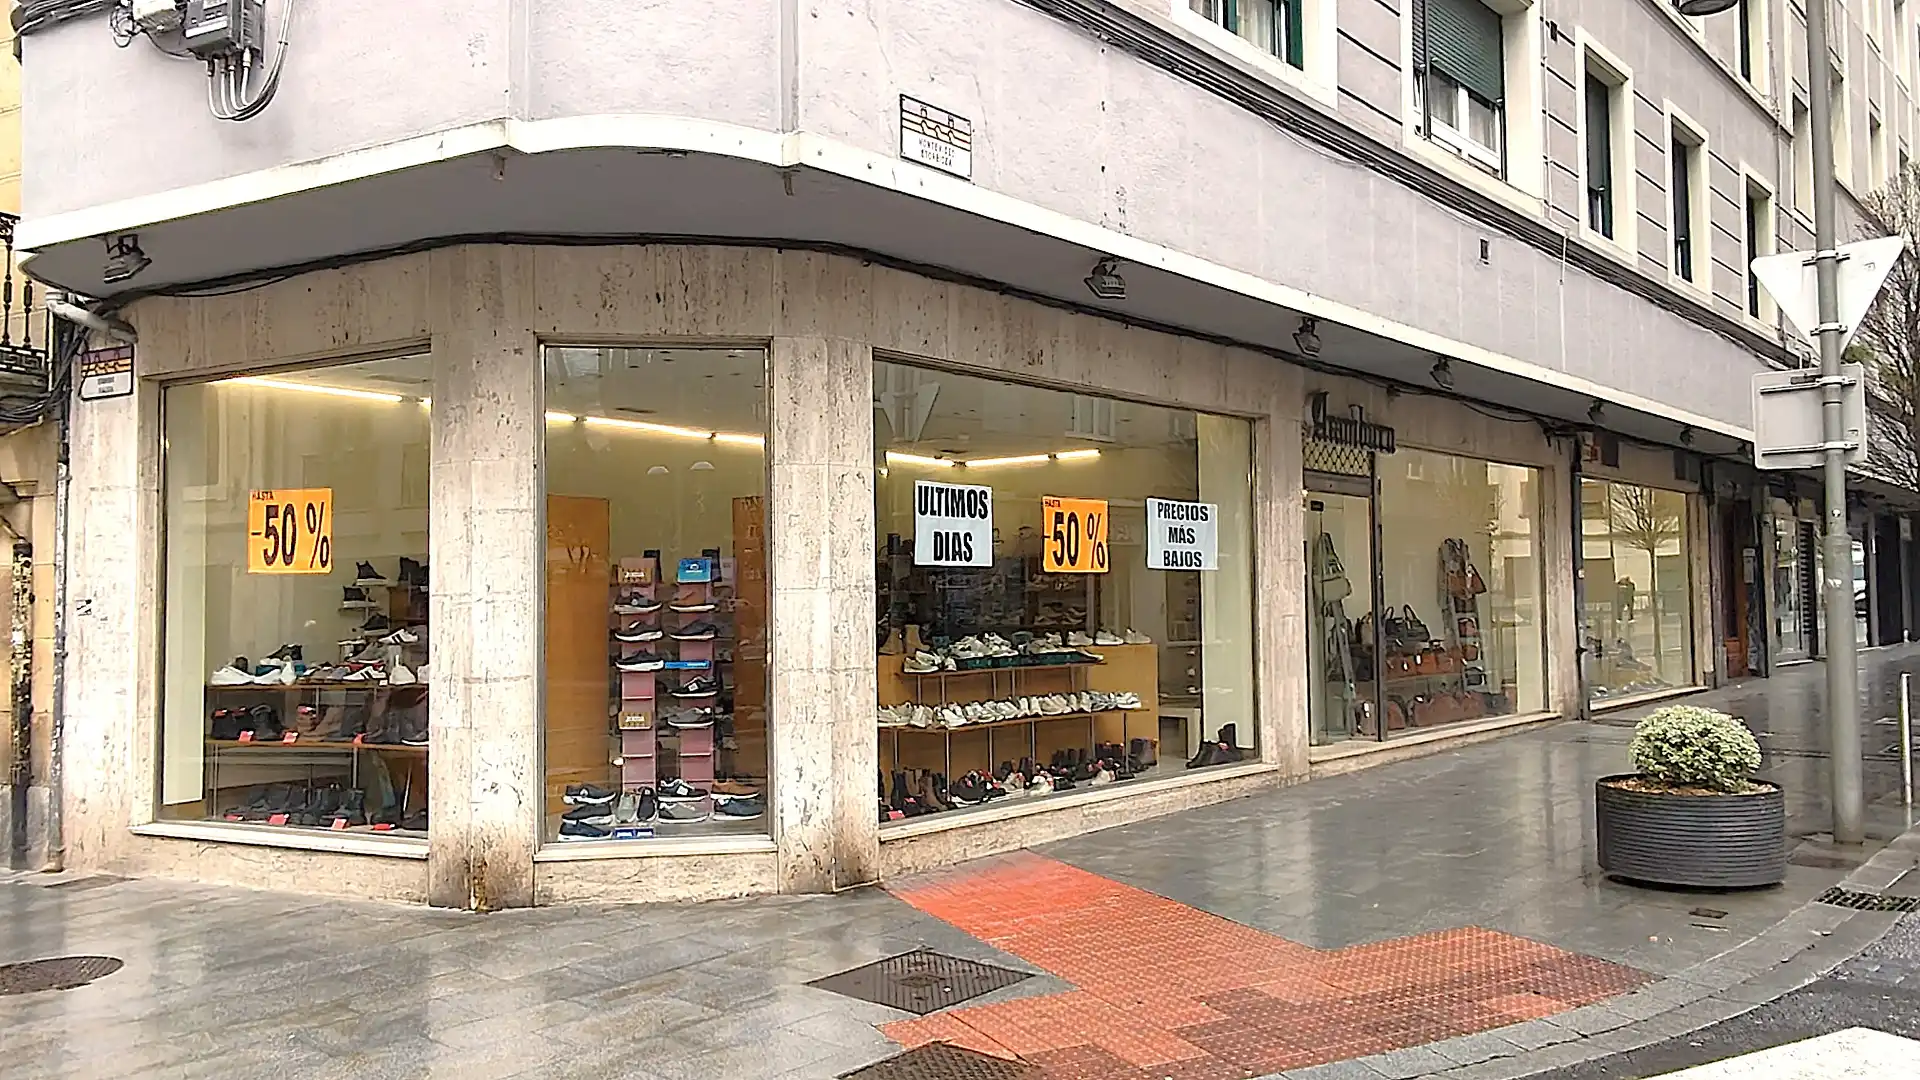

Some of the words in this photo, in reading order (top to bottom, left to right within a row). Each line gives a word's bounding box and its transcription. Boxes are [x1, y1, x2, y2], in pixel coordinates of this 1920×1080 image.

[918, 485, 988, 519] ULTIMOS
[1158, 501, 1208, 521] PRECIOS
[1168, 524, 1195, 544] MÁS
[933, 531, 972, 562] DIAS
[1163, 550, 1202, 568] BAJOS
